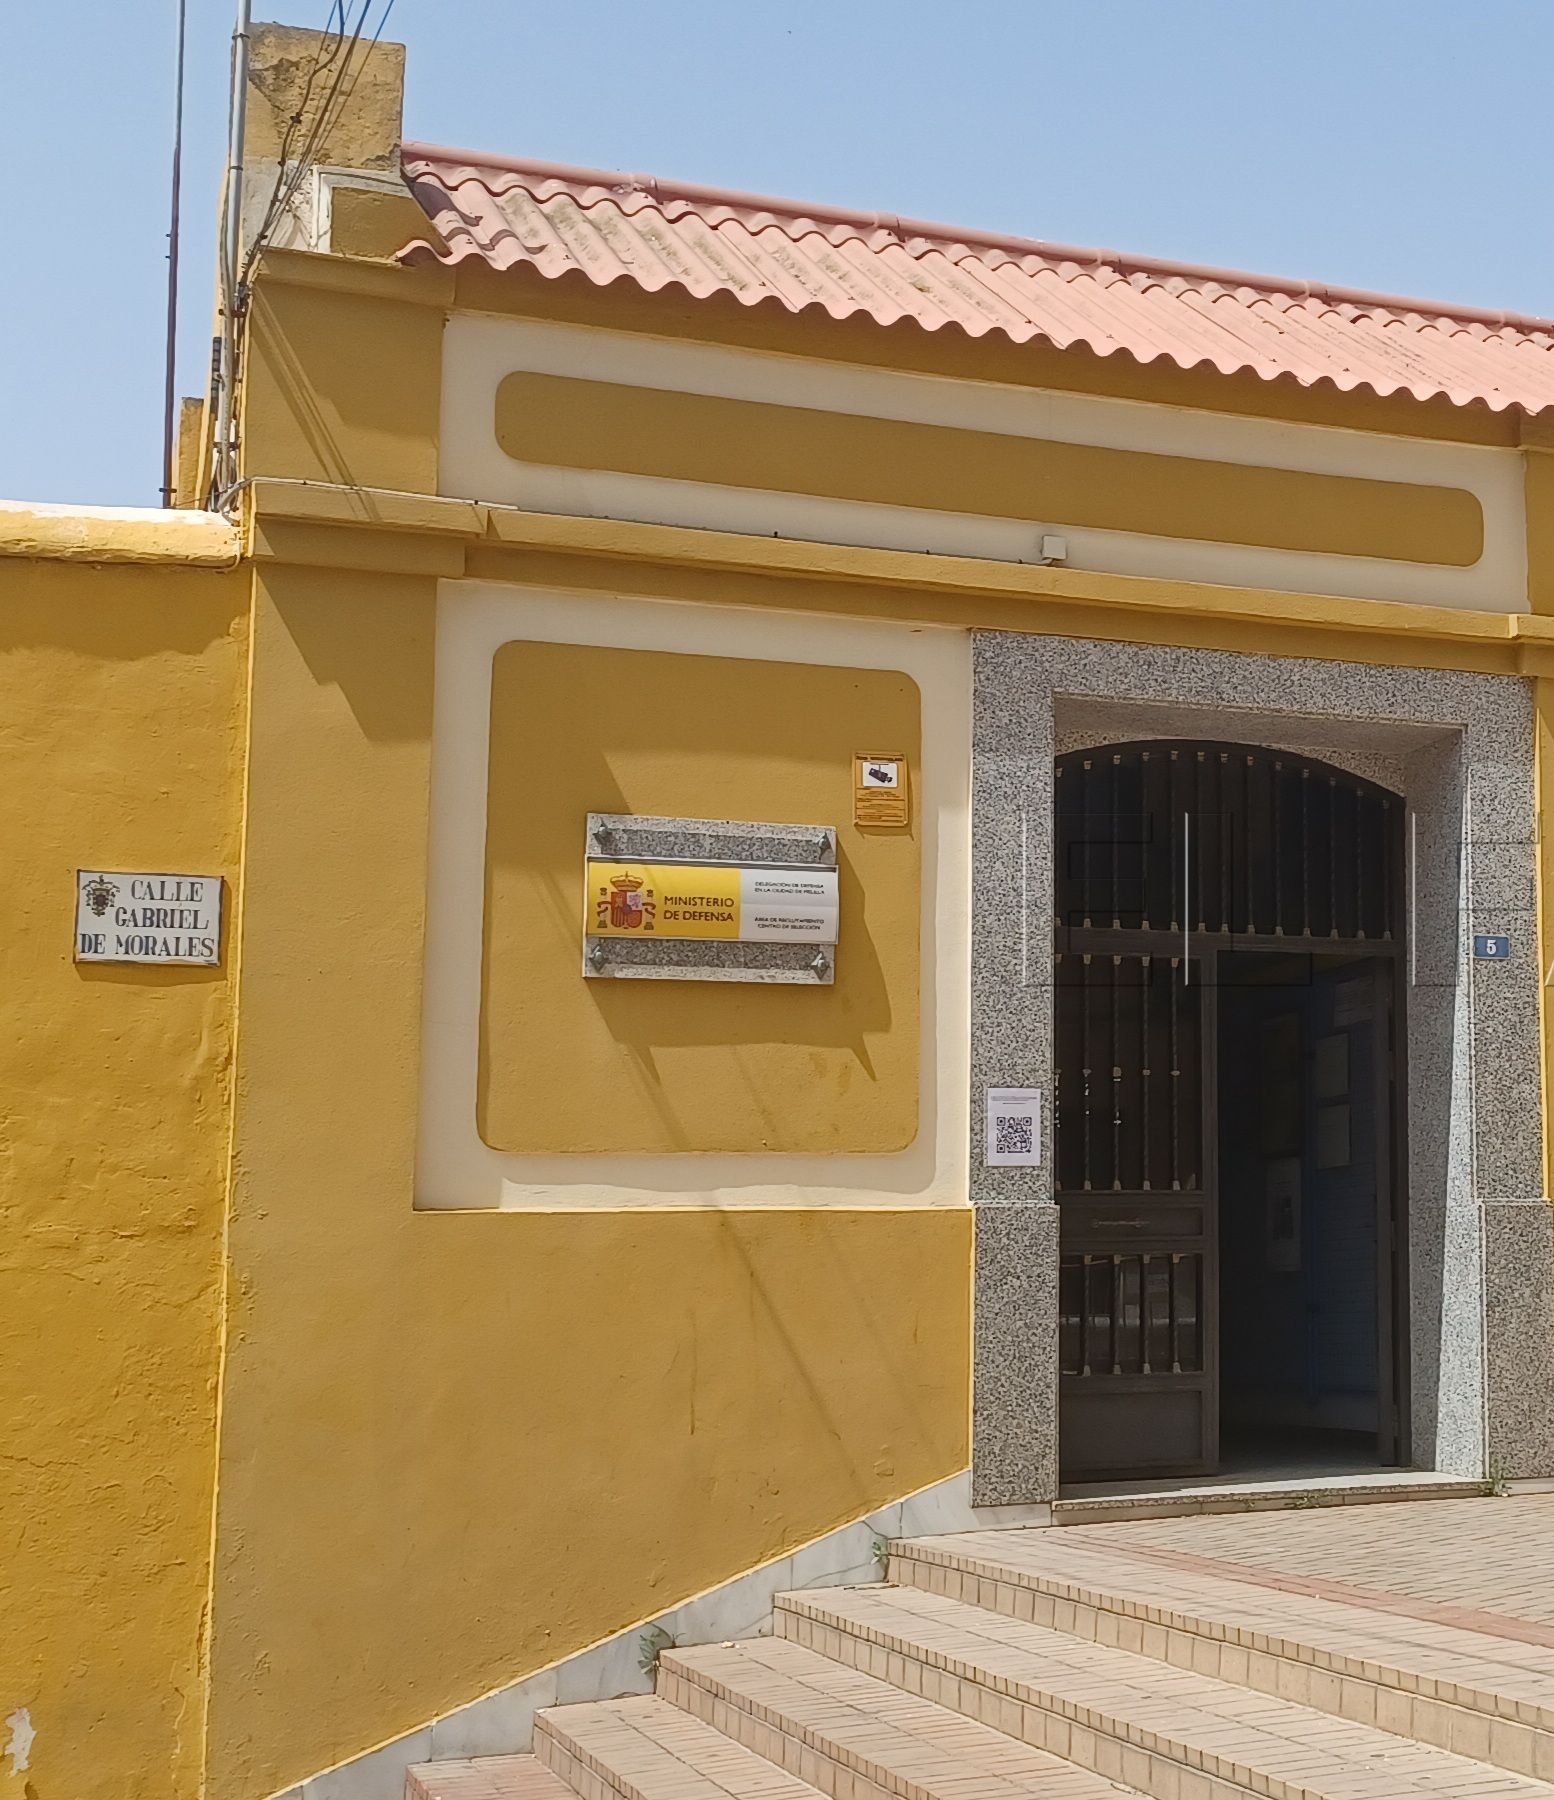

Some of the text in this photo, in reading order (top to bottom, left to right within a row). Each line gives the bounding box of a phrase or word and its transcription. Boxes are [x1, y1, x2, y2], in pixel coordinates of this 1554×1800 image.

[130, 879, 204, 903] CALLE
[664, 896, 735, 908] MINISTERIO
[114, 906, 210, 930] GABRIEL
[663, 909, 735, 922] DE DEFENSA
[79, 933, 216, 958] DE MORALES
[1486, 939, 1497, 955] 5
